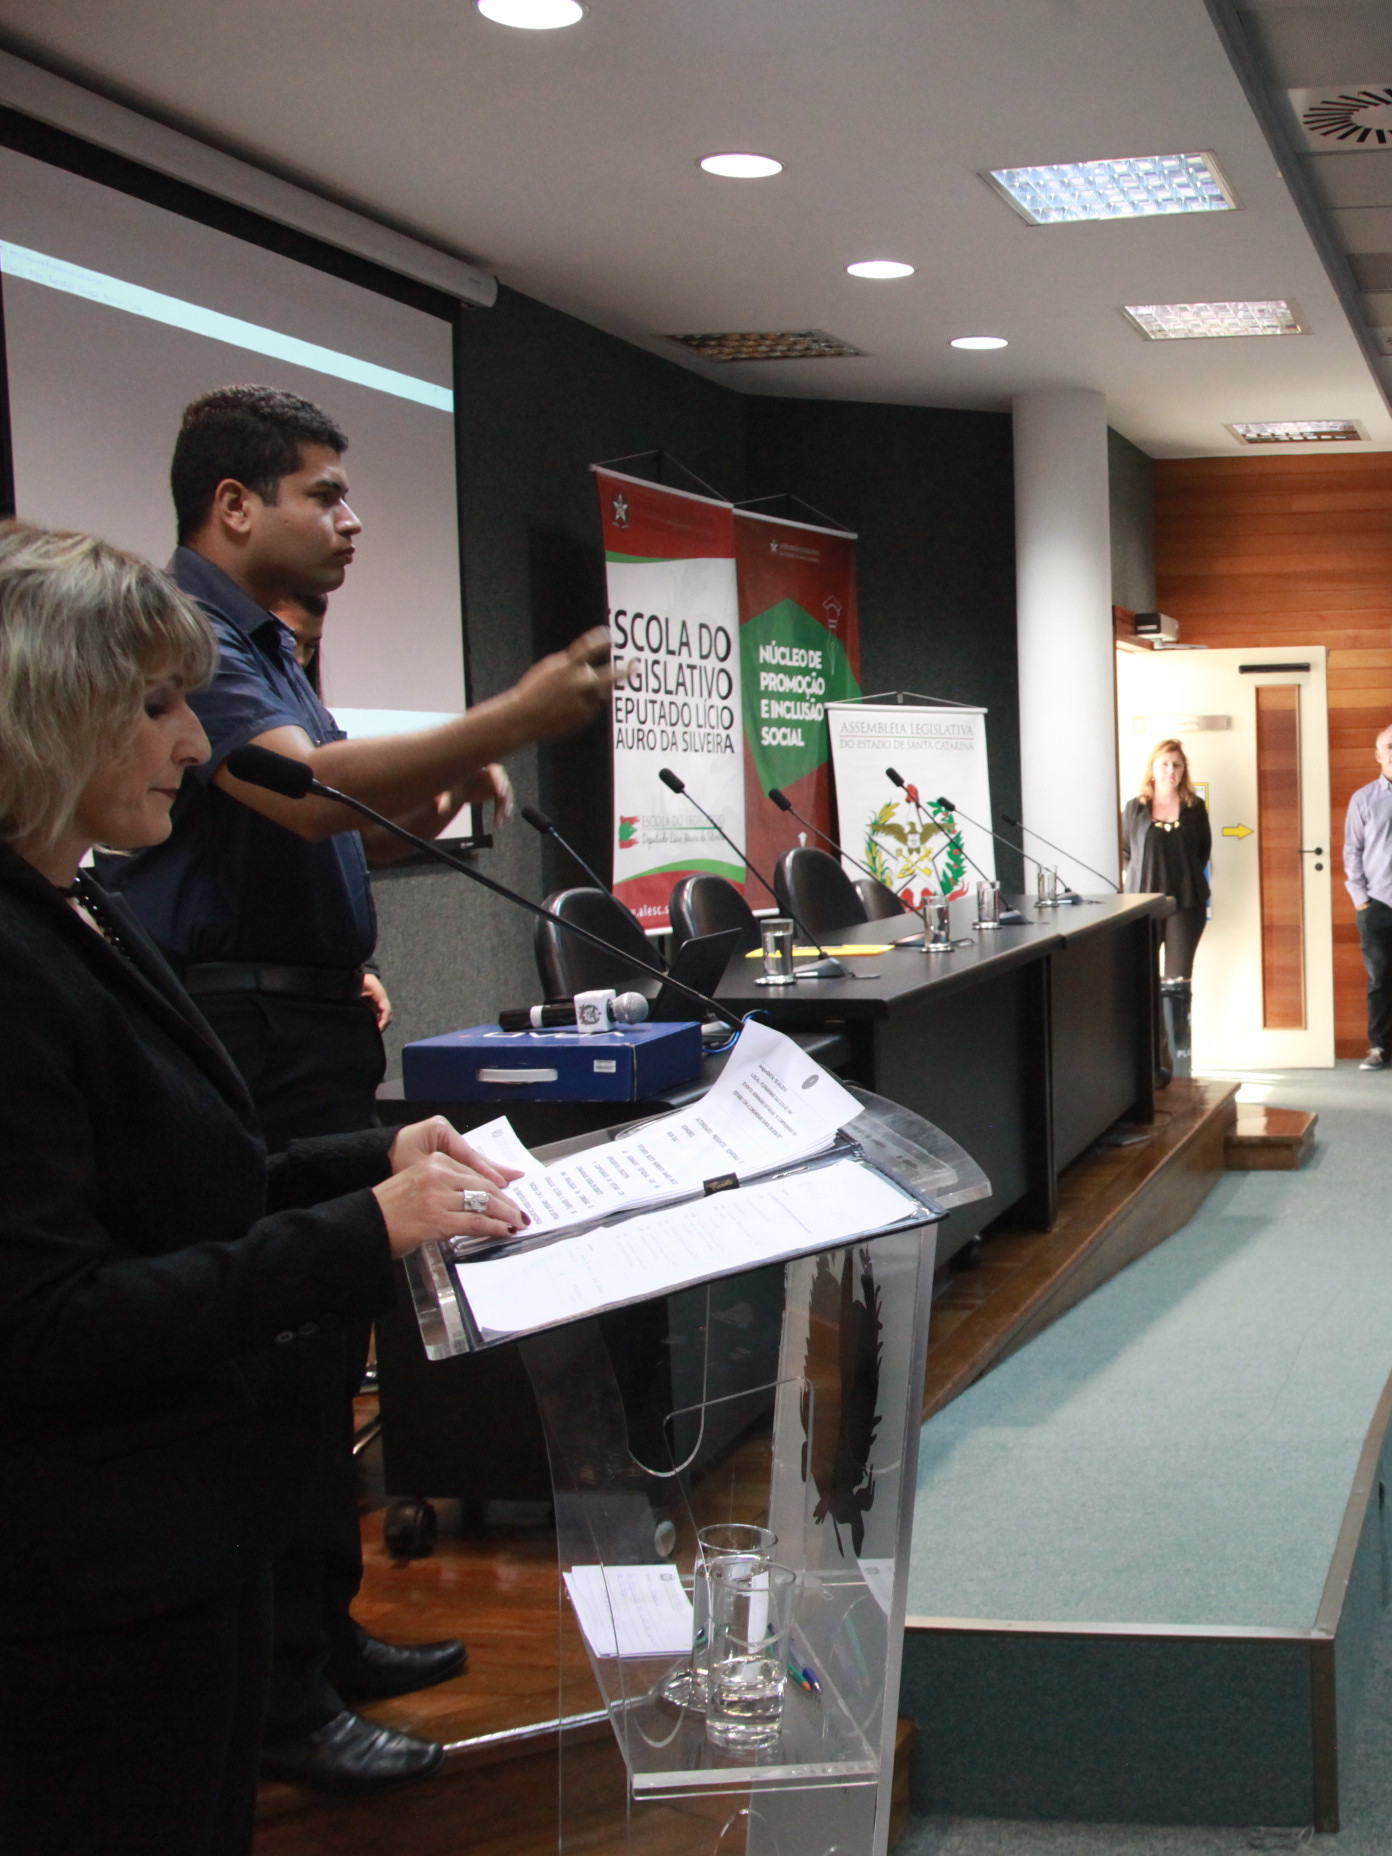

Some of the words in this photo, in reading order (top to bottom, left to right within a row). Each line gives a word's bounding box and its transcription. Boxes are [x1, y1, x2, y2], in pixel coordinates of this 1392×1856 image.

[608, 608, 692, 658] SCOLA
[699, 622, 731, 662] DO
[759, 640, 808, 667] NÚCLEO
[808, 649, 823, 669] DE
[613, 655, 733, 700] EGISLATIVO
[760, 671, 825, 699] PROMOÇÃO
[615, 696, 692, 728] EPUTADO
[695, 699, 734, 730] LÍCIO
[760, 699, 770, 719] E
[770, 698, 824, 721] INCLUSÃO
[616, 727, 657, 750] AURO
[660, 730, 678, 752] DA
[682, 731, 735, 754] SILVEIRA
[761, 726, 805, 746] SOCIAL
[840, 721, 907, 735] ASSEMBLEIA
[910, 722, 974, 736] LEGISLATIVA
[840, 739, 855, 749] DO
[857, 740, 891, 749] ESTADO
[894, 740, 905, 750] DE
[907, 740, 933, 751] SANTA
[935, 741, 975, 751] CATARINA
